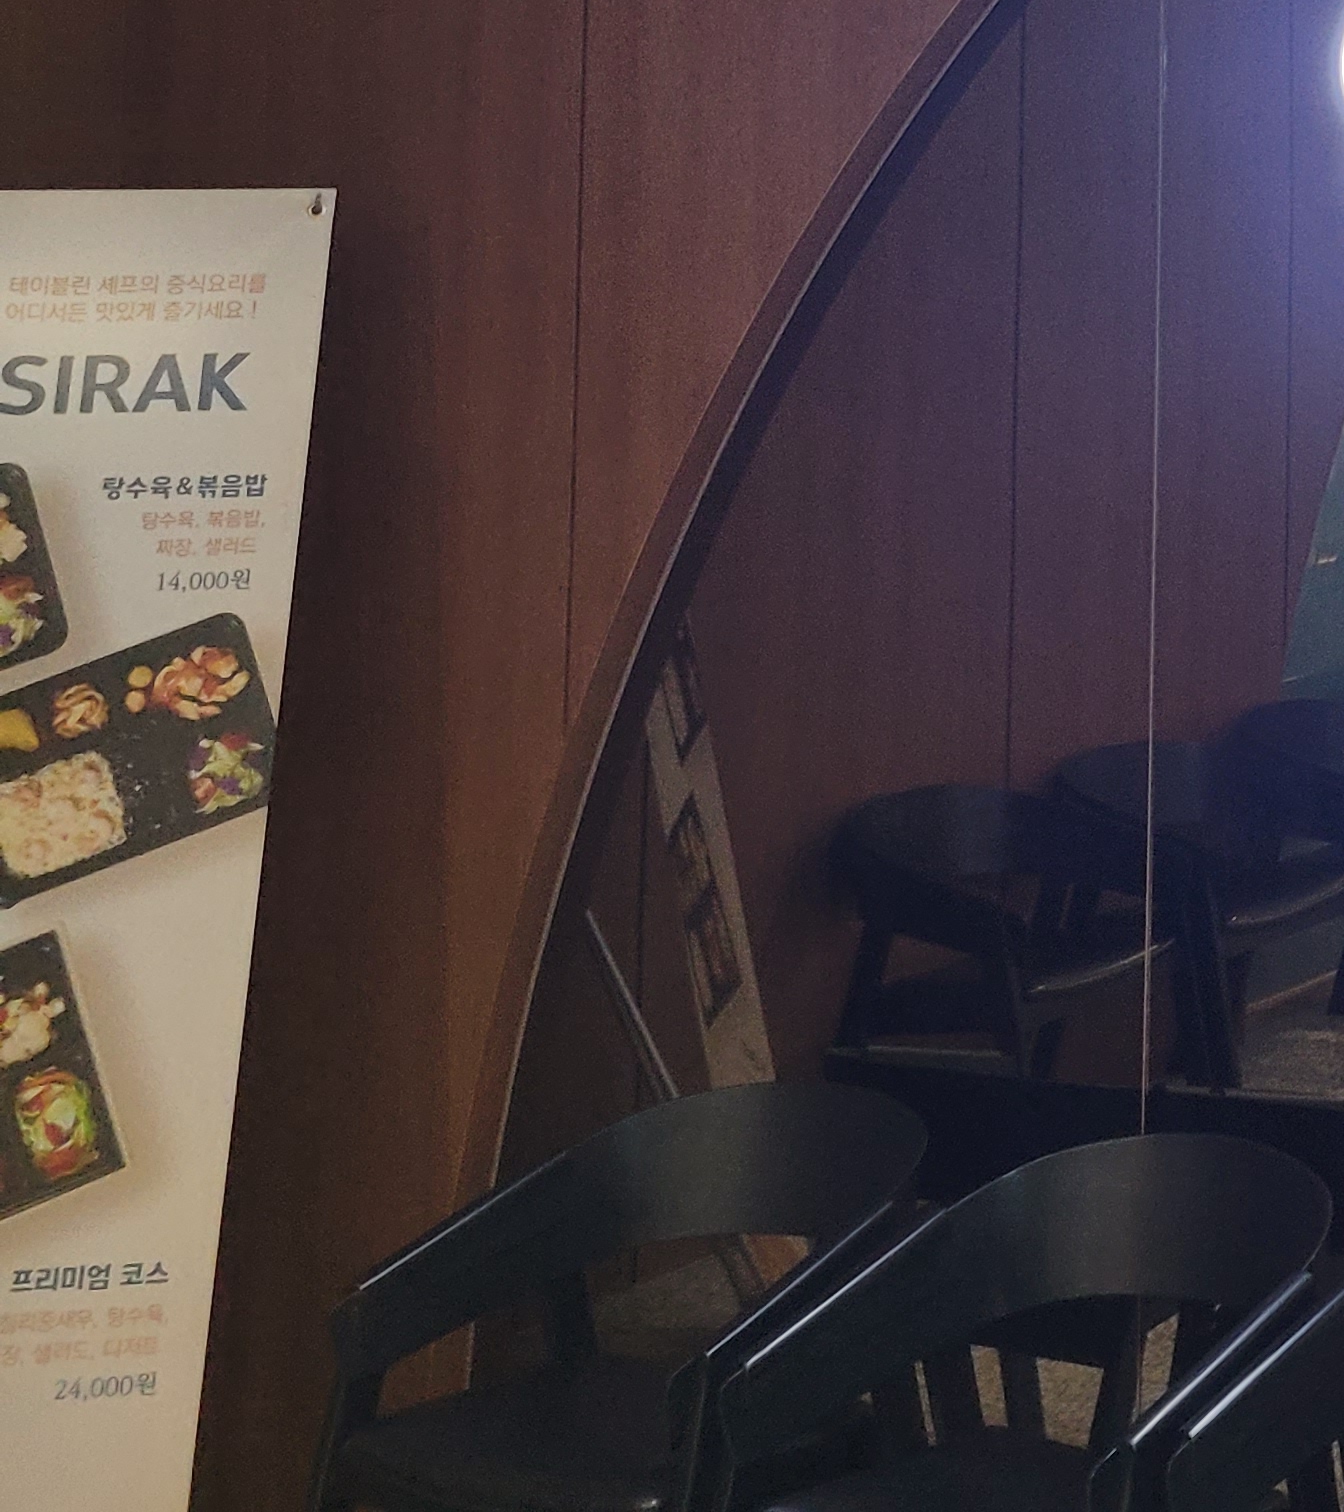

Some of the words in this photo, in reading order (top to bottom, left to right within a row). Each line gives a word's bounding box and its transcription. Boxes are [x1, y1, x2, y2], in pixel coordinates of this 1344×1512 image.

[9, 274, 91, 297] 테이블린
[166, 272, 267, 295] 중식요리를
[4, 301, 89, 324] 어디서든
[96, 300, 156, 323] 맛있게
[0, 351, 252, 416] SIRAK
[102, 473, 268, 500] 탕수육&볶음밥
[157, 568, 251, 593] 14,000원
[10, 1263, 112, 1293] 프리미엄
[119, 1260, 170, 1287] 코스
[54, 1371, 158, 1402] 24,000원
